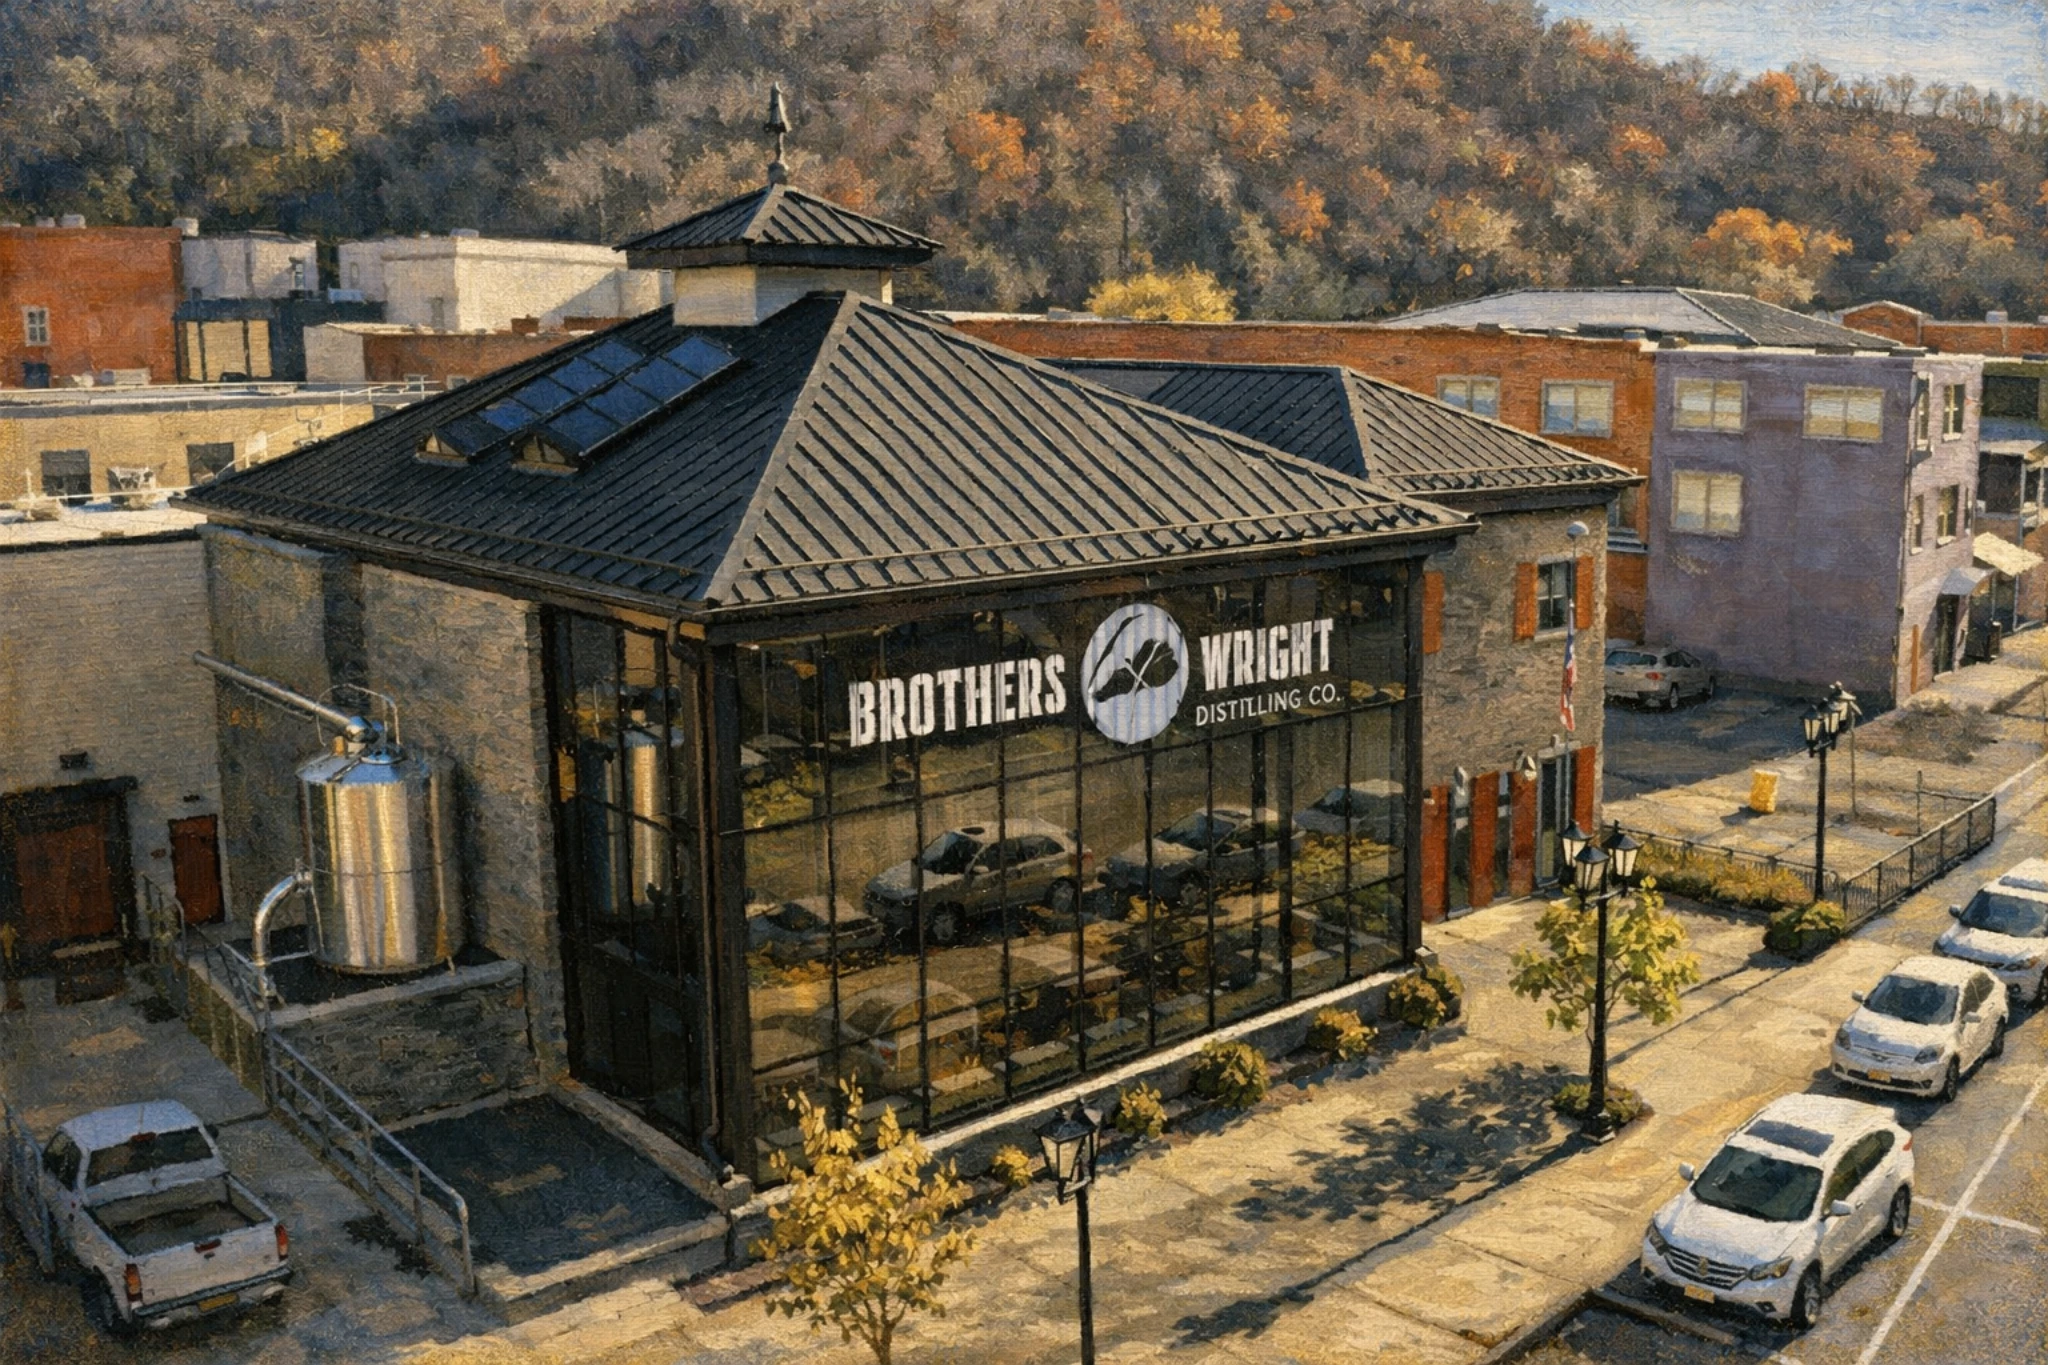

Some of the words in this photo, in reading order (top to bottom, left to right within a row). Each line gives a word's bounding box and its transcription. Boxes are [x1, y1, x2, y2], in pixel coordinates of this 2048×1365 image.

[849, 654, 1067, 748] BROTHERS
[1199, 617, 1334, 692] WRIGHT
[1308, 682, 1342, 706] CO.
